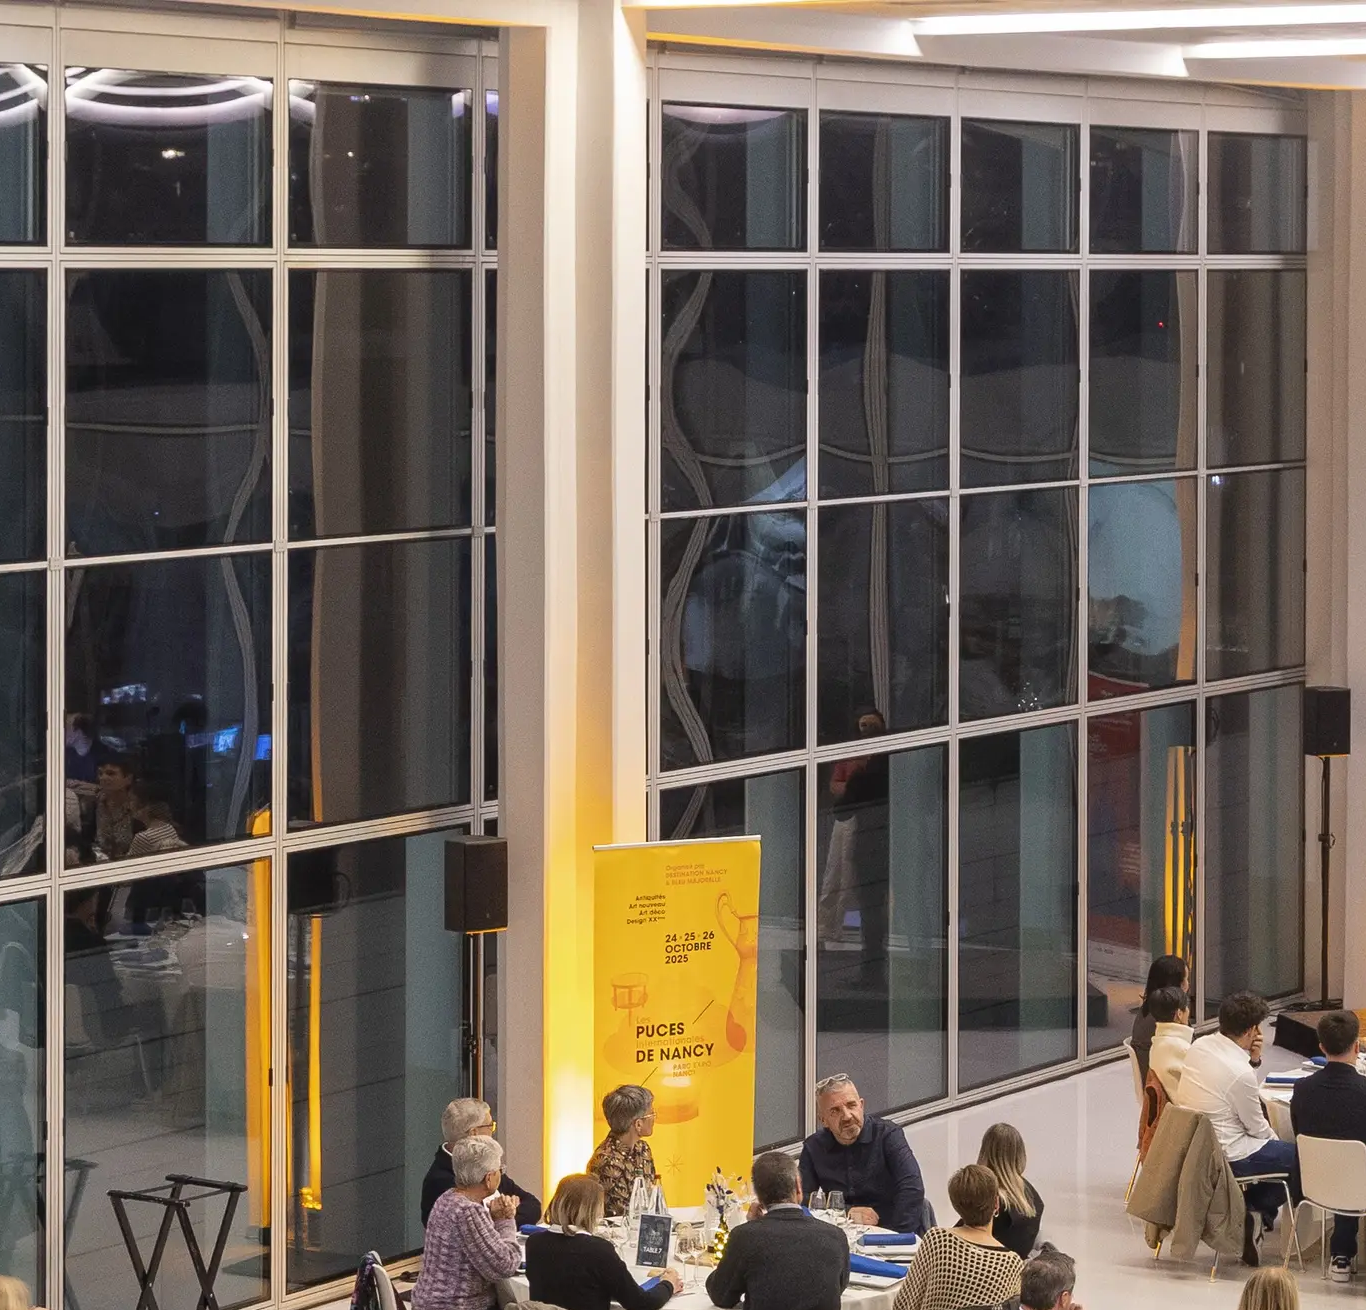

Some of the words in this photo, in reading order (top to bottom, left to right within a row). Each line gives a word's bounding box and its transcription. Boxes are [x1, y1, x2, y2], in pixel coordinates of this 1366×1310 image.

[665, 933, 677, 943] 24
[684, 932, 696, 942] 25
[702, 930, 715, 940] 26
[665, 941, 712, 954] OCTOBRE
[665, 954, 689, 964] 2025
[636, 1022, 685, 1039] PUCES
[636, 1049, 654, 1063] DE
[660, 1043, 714, 1061] NANCY
